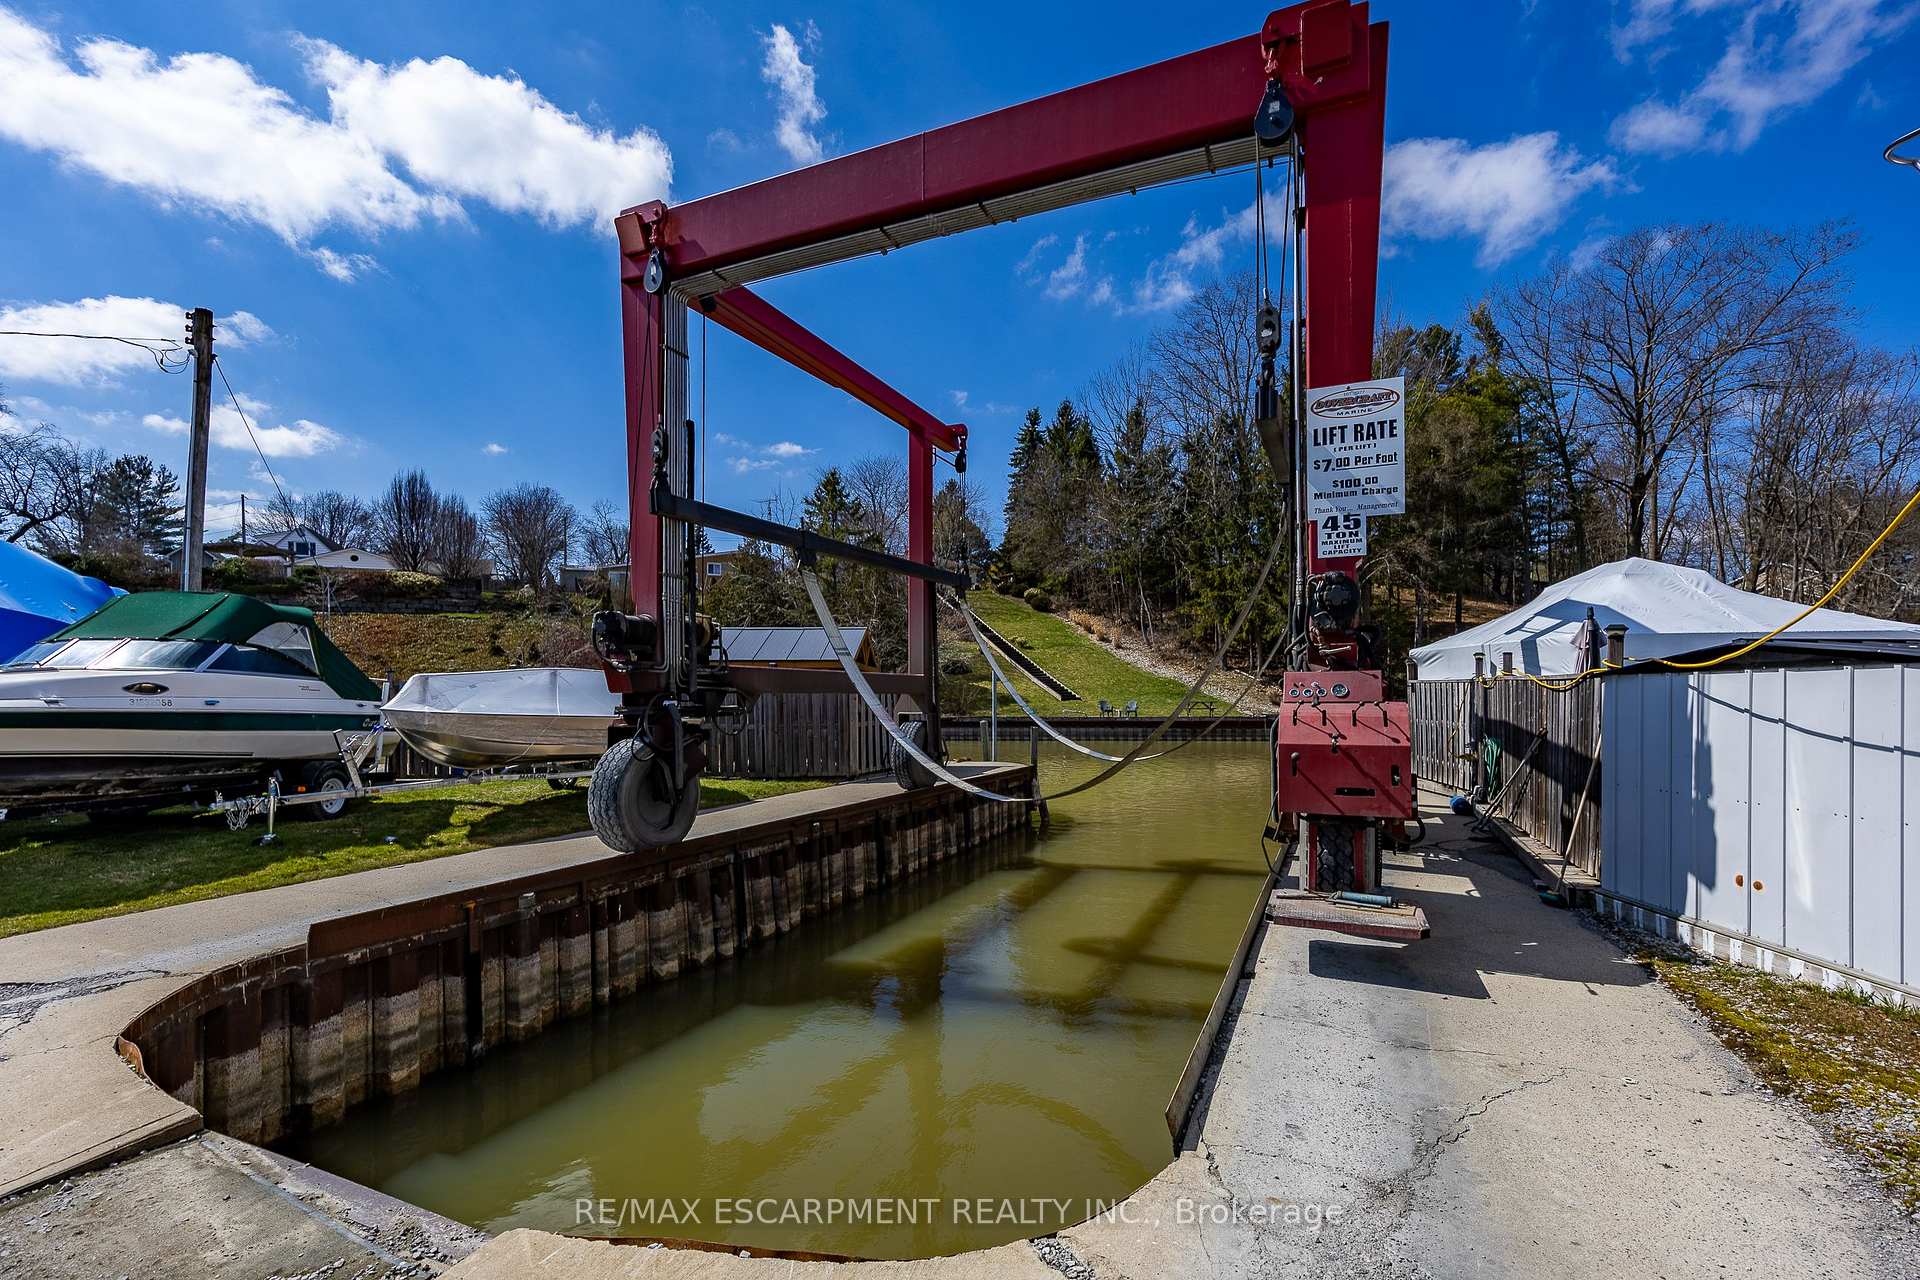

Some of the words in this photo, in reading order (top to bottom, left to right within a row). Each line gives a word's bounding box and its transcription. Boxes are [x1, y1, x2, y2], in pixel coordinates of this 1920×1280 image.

[1336, 407, 1374, 416] MARINE
[1313, 424, 1348, 447] LIFT
[1353, 419, 1398, 442] RATE
[1313, 456, 1351, 473] $7.00
[1354, 455, 1374, 466] Per
[1375, 452, 1398, 464] Foot
[1332, 476, 1379, 489] $100.00
[1313, 490, 1358, 500] Minimum
[1361, 486, 1399, 496] Charge
[1314, 506, 1334, 514] Thank
[1356, 501, 1398, 511] Management
[1322, 513, 1361, 532] 45
[1325, 530, 1360, 540] TON
[1321, 538, 1363, 546] MAXIMUM
[1322, 548, 1362, 556] CAPACITY
